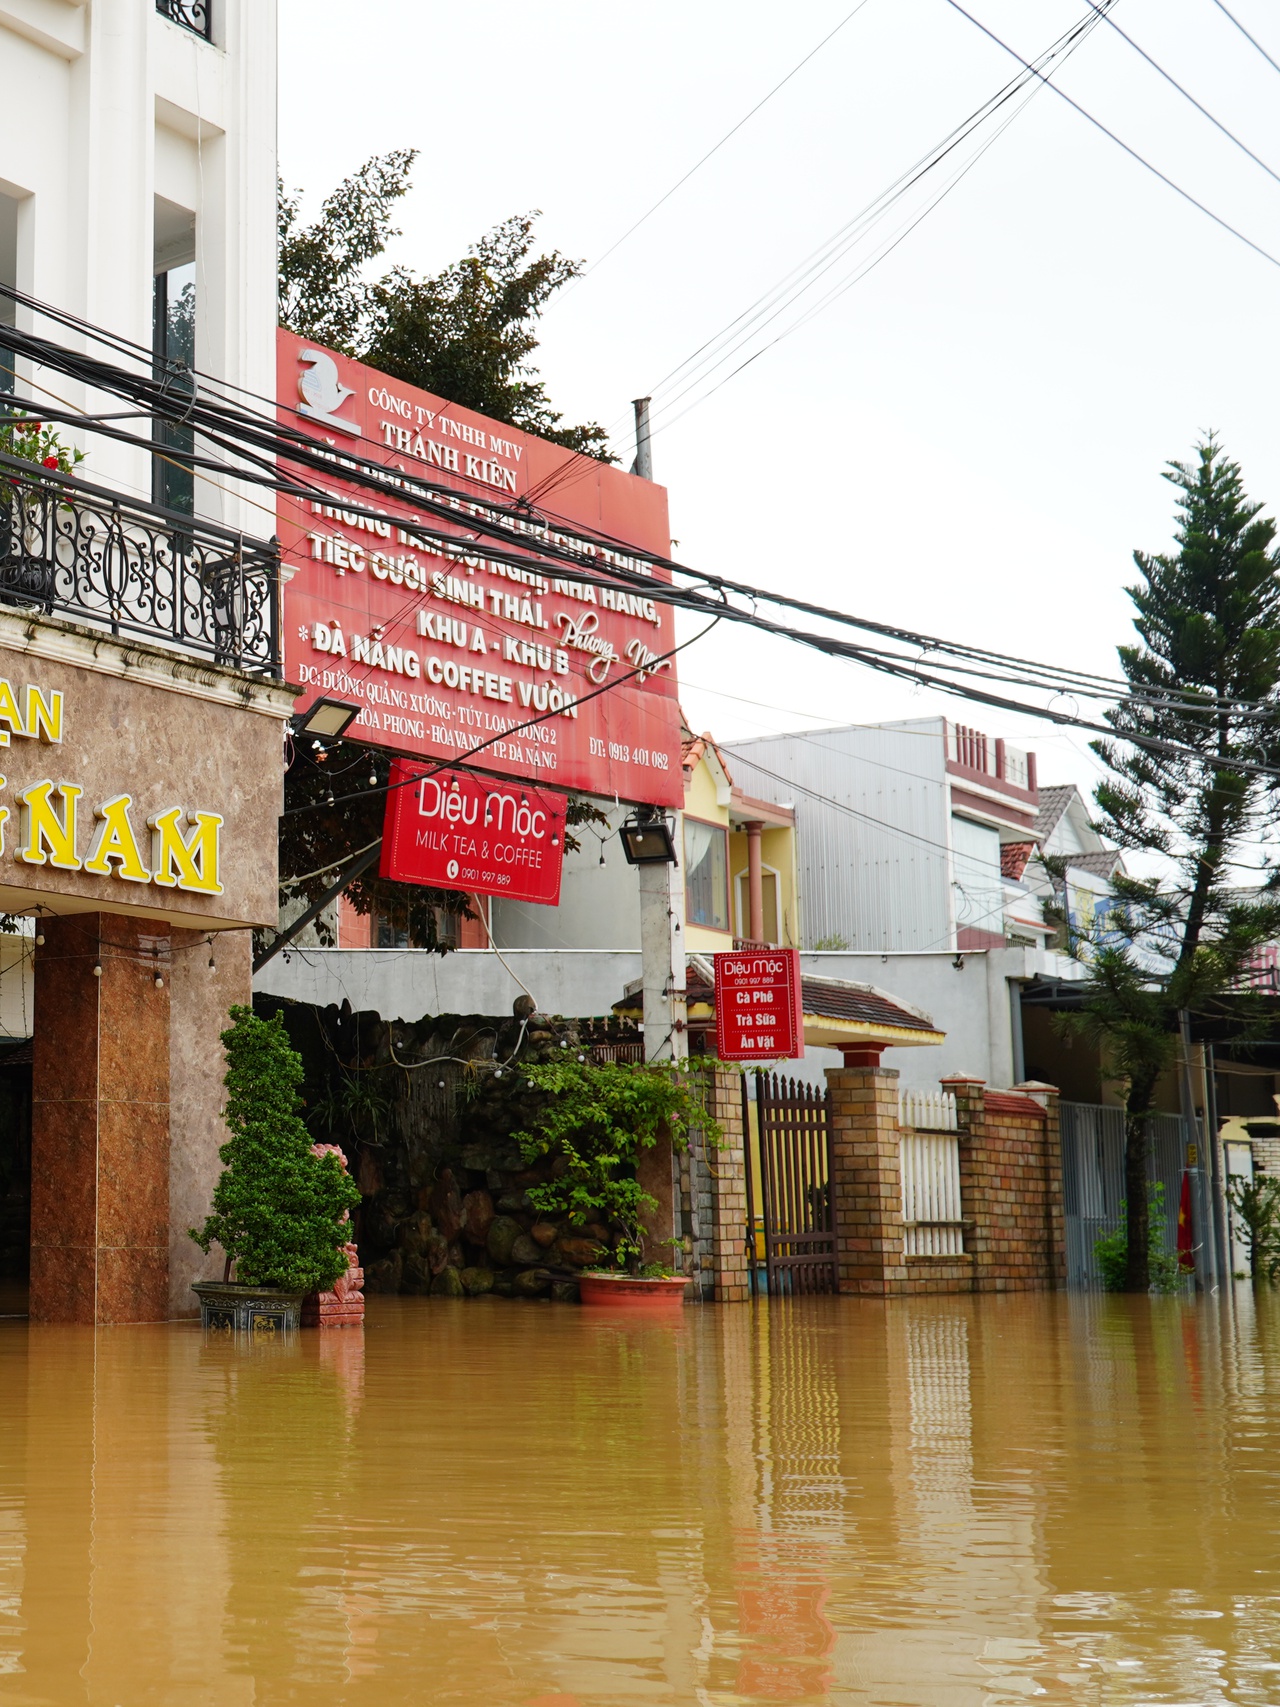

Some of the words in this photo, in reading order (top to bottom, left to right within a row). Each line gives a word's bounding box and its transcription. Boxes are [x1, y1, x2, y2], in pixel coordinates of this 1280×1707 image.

[369, 387, 412, 420] CÔNG
[414, 405, 437, 431] TY
[438, 415, 487, 450] TNHH
[489, 434, 522, 462] MTV
[380, 420, 461, 475] THÀNH
[464, 455, 517, 493] KIÊN
[308, 532, 366, 577] TIỆC
[370, 552, 427, 593] CƯỚI
[430, 571, 484, 609] SINH
[487, 588, 549, 631] THÁI.
[311, 620, 347, 658] ĐÀ
[350, 624, 420, 679] NẴNG
[424, 656, 513, 703] COFFEE
[515, 679, 578, 719] VƯỜN
[417, 609, 467, 648] KHU
[470, 627, 487, 654] A
[503, 636, 551, 671] KHU
[553, 648, 569, 675] B
[299, 663, 321, 687] ĐC:
[323, 669, 365, 698] ĐƯỜNG
[366, 680, 408, 709] QUẢNG
[409, 693, 451, 719] XƯƠNG
[458, 705, 482, 728] TÚY
[485, 713, 515, 737] LOAN
[550, 729, 557, 746] 2
[355, 704, 380, 729] HÒA
[382, 713, 424, 739] PHONG
[508, 742, 523, 763] ĐÀ
[589, 736, 606, 758] ĐT:
[608, 742, 630, 763] 0913
[632, 747, 650, 767] 401
[651, 751, 669, 771] 082
[15, 779, 224, 896] NAM
[419, 777, 478, 830] Diệu
[484, 792, 546, 844] Mộc
[416, 829, 450, 852] MILK
[453, 835, 477, 857] TEA
[481, 841, 489, 859] &
[494, 843, 542, 869] COFFEE
[461, 867, 480, 880] 0901
[482, 871, 495, 883] 997
[497, 874, 511, 886] 889
[724, 961, 751, 977] Diệu
[753, 959, 783, 976] Mộc
[736, 992, 750, 1004] Cà
[753, 990, 773, 1003] Phê
[736, 1014, 753, 1026] Trà
[755, 1013, 776, 1025] Sữa
[740, 1034, 755, 1048] Ăn
[757, 1035, 774, 1050] Vặt
